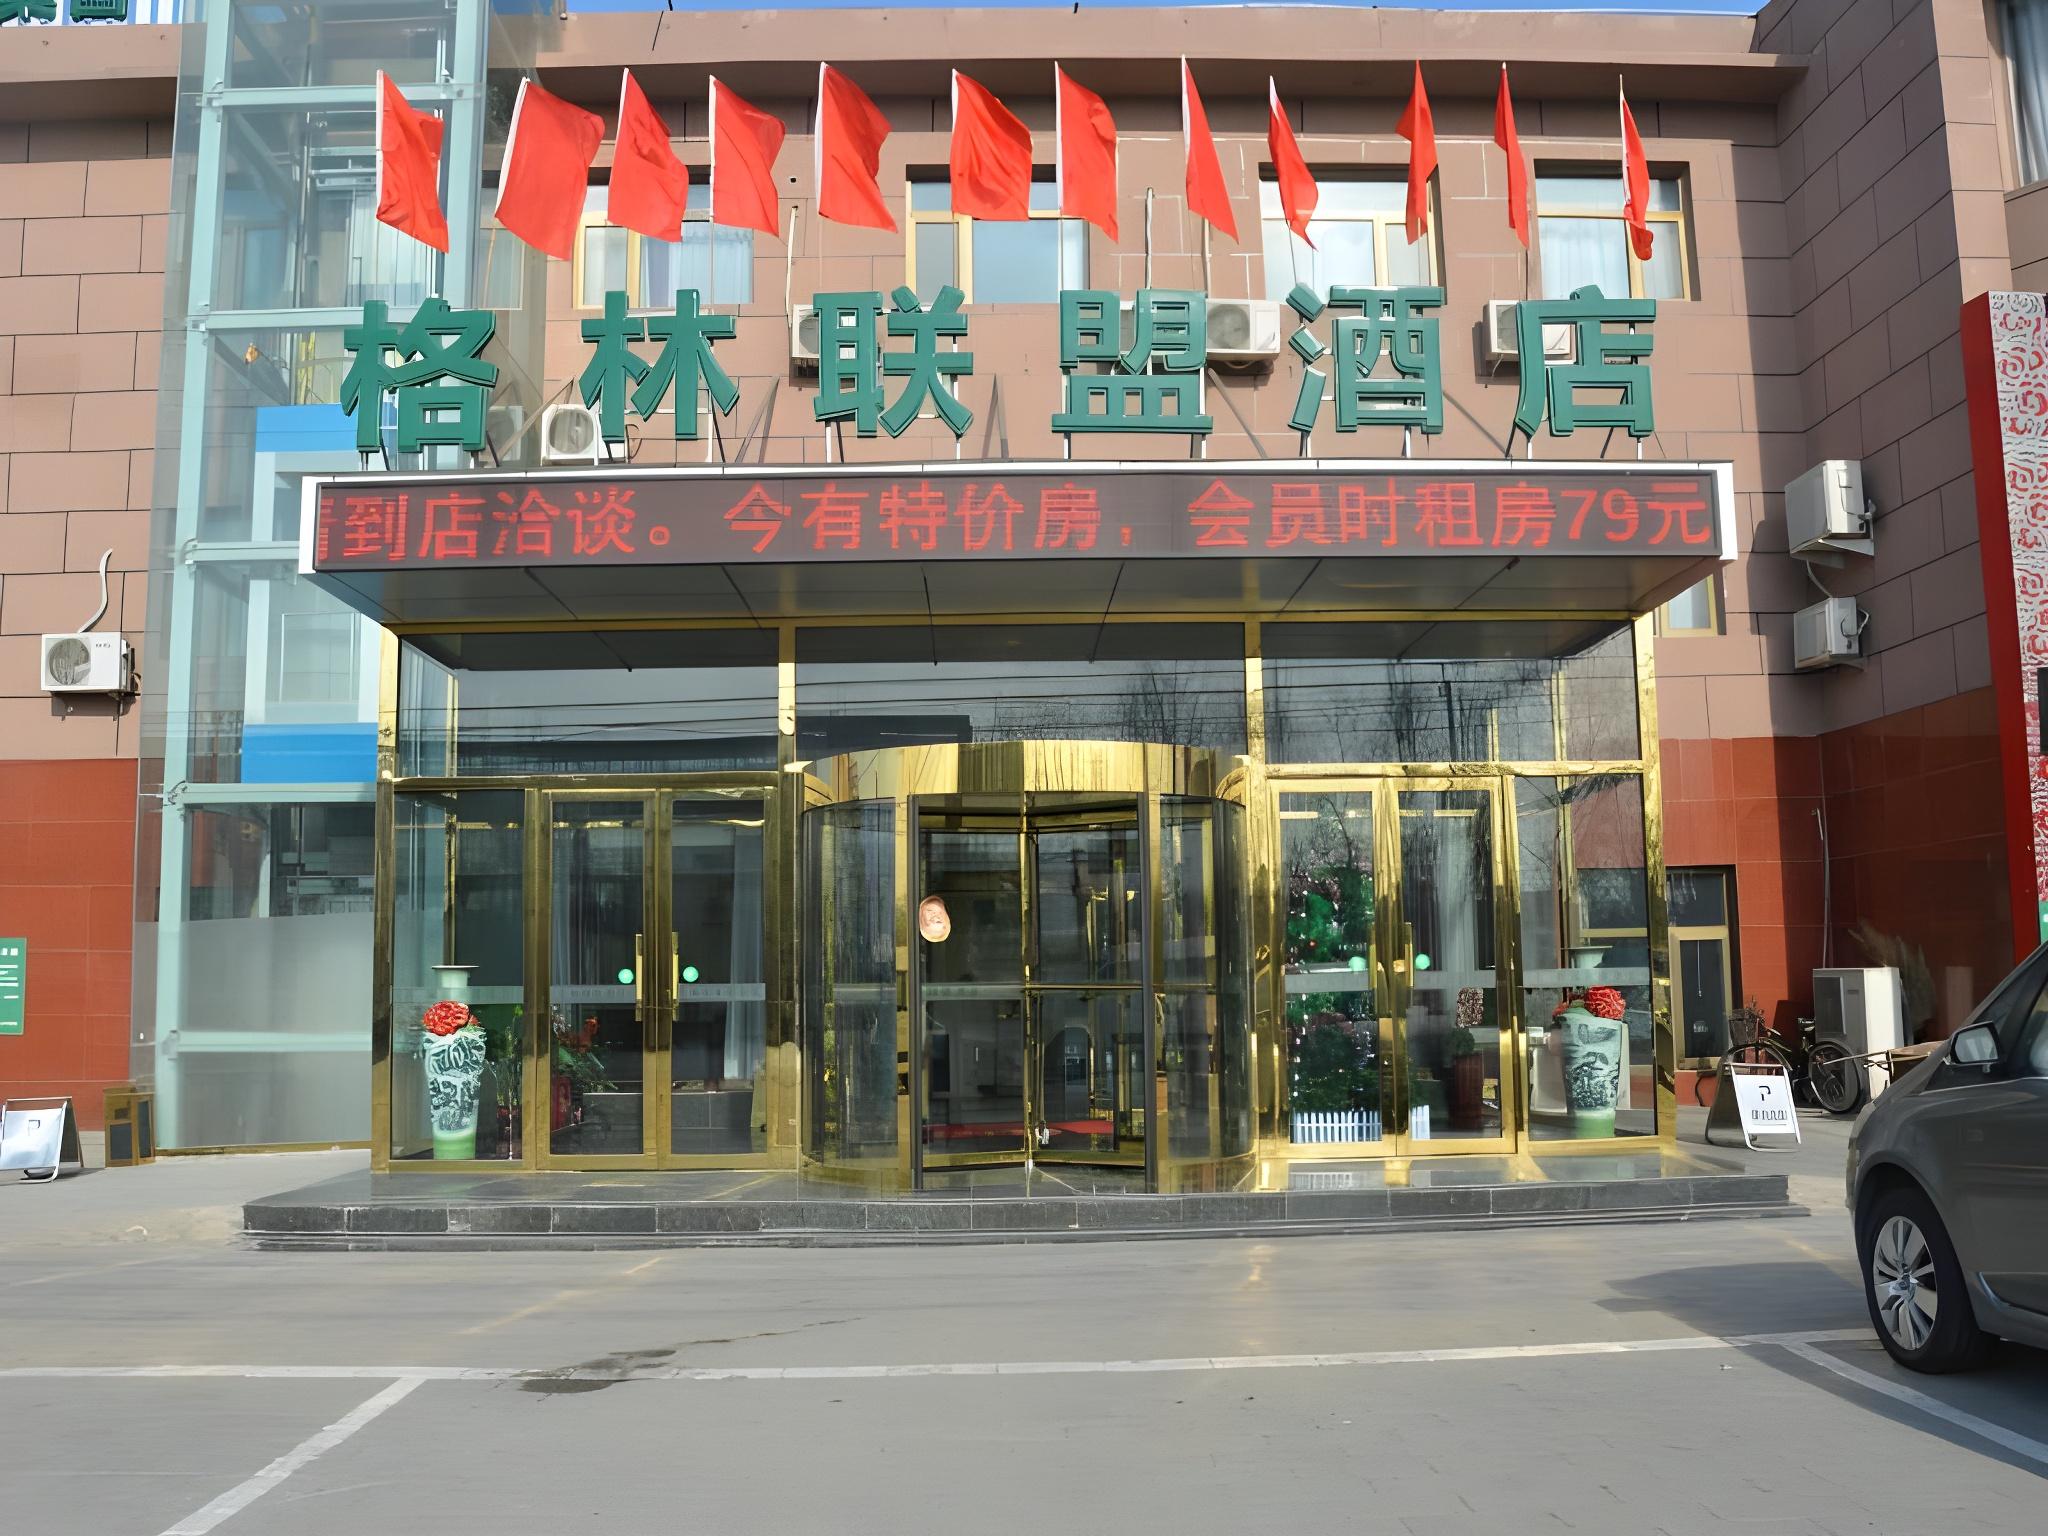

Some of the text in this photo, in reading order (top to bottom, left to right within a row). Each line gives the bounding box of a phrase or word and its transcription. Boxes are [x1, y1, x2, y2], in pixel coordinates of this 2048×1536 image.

[340, 283, 1657, 453] 格林联盟酒店
